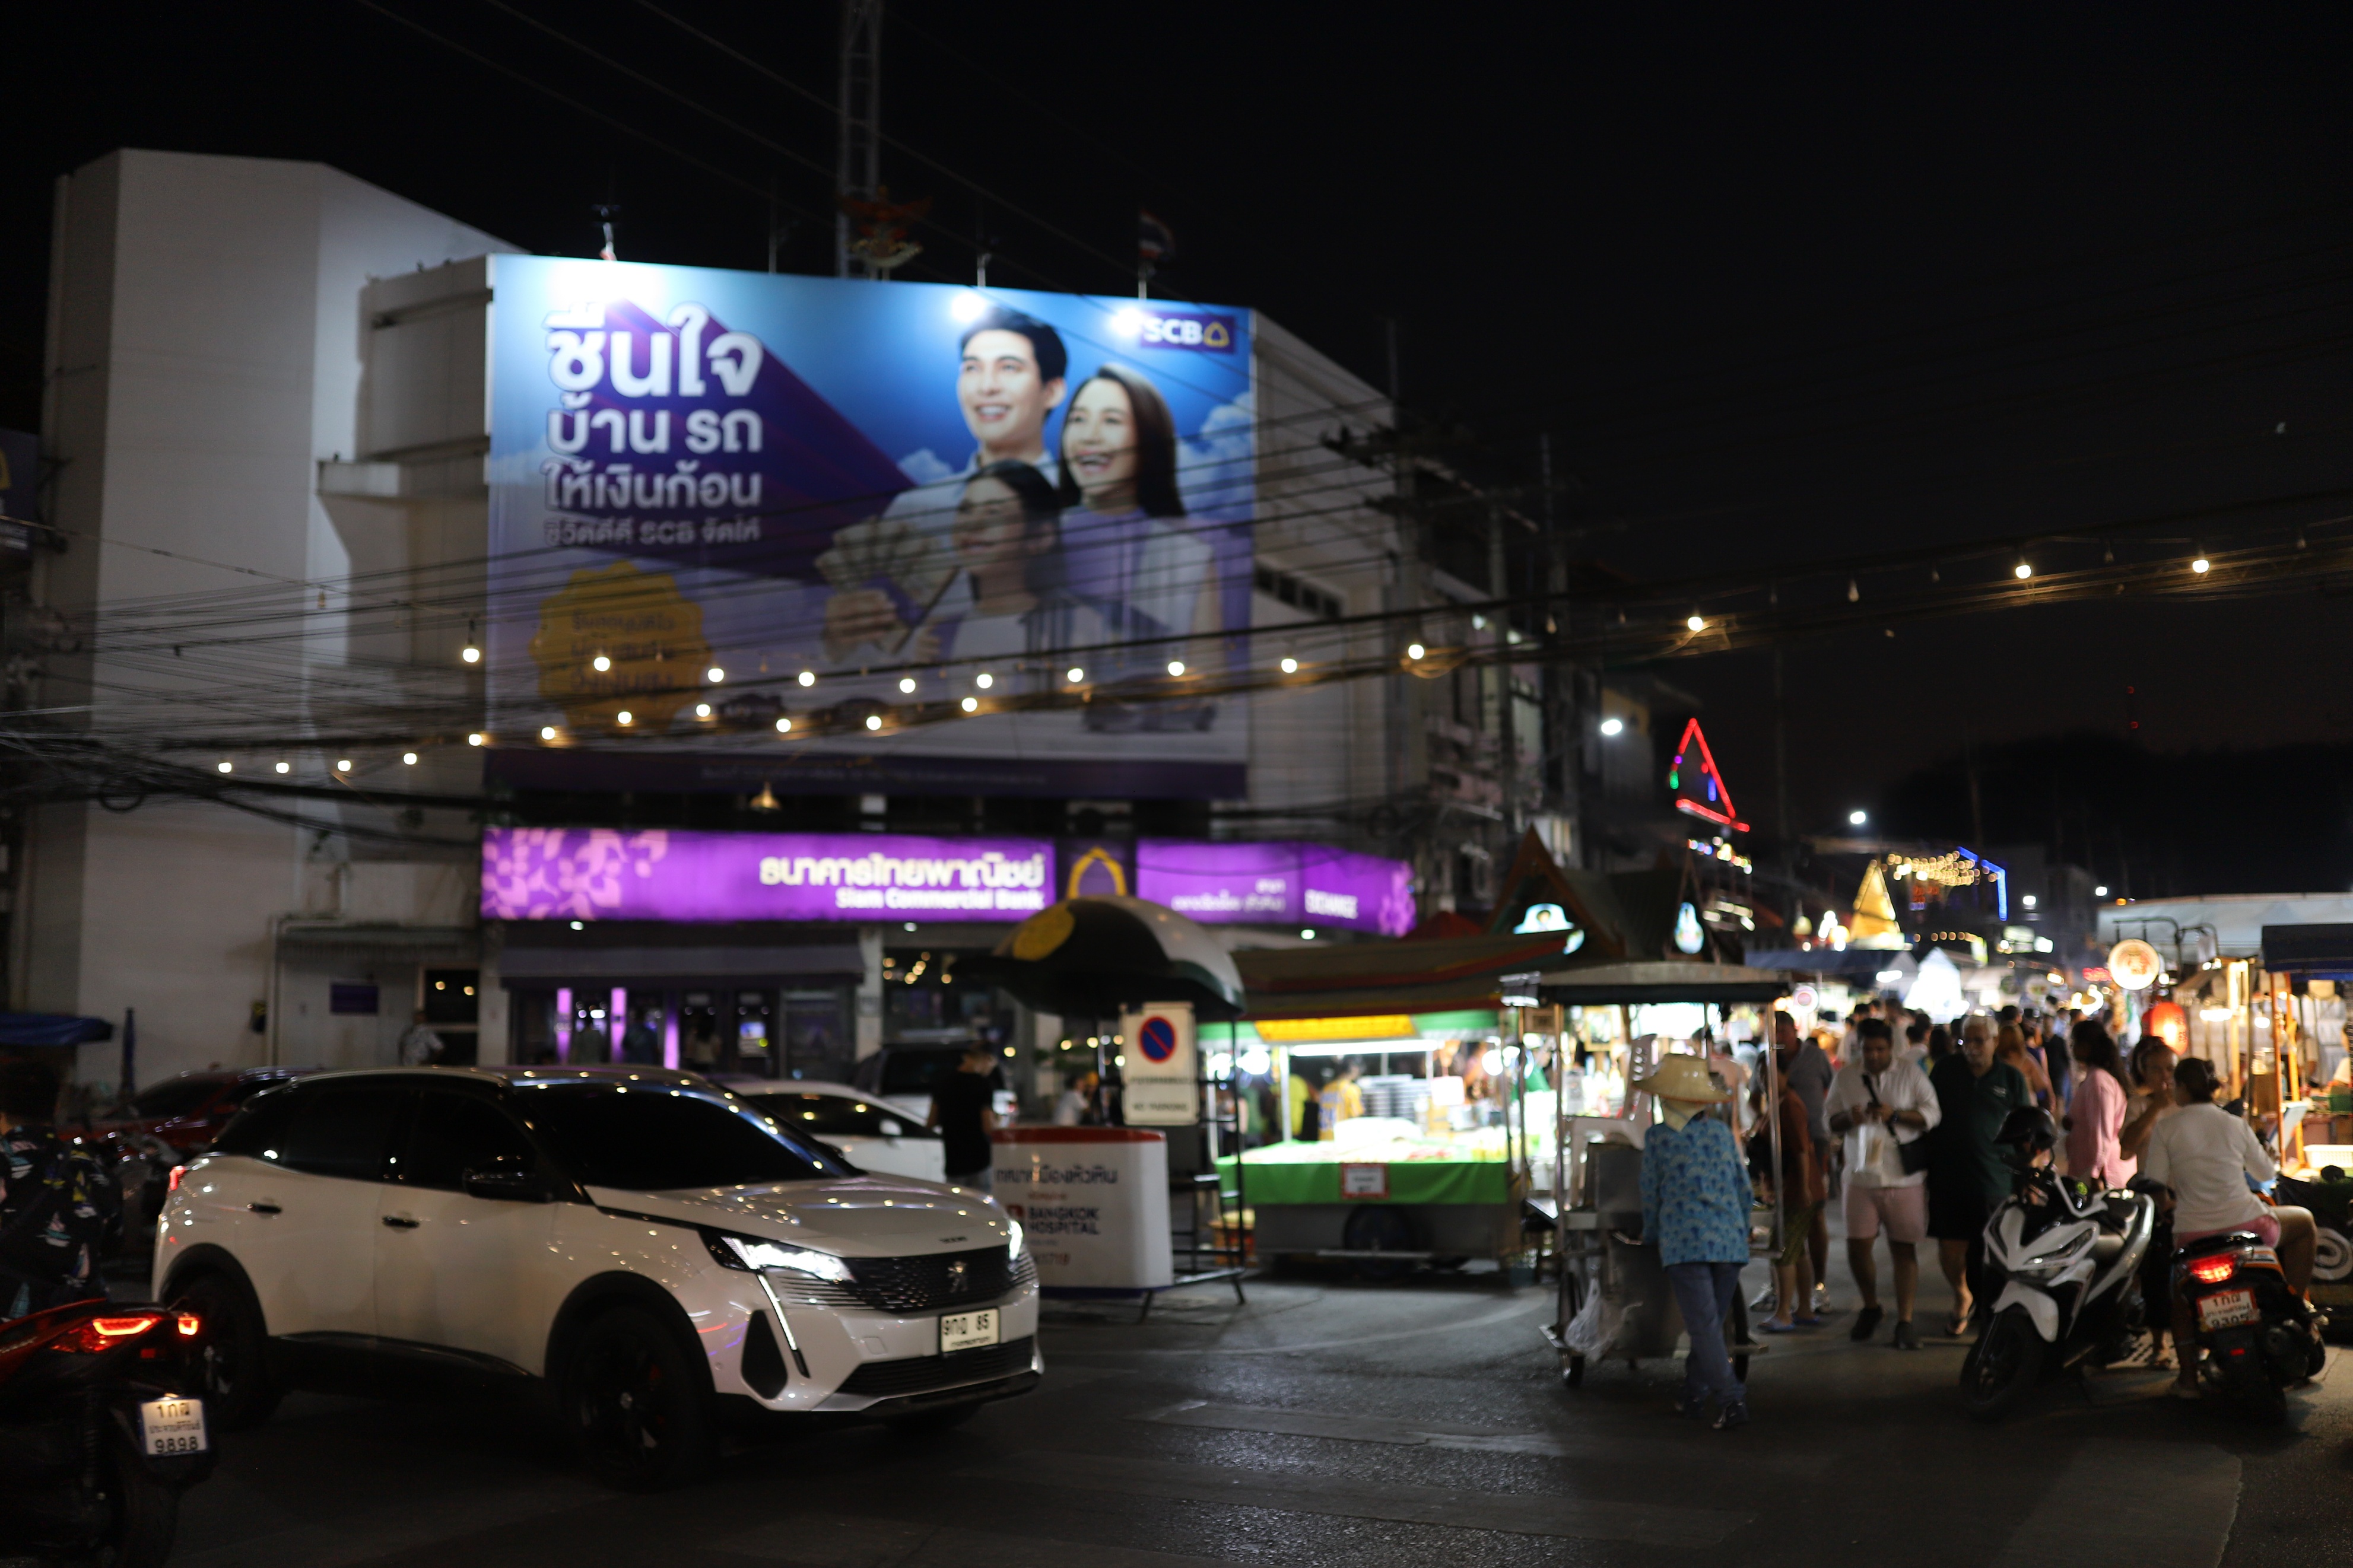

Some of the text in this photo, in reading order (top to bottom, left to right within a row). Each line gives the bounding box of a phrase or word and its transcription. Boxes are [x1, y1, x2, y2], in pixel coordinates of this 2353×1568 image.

[1142, 316, 1204, 345] SCB
[542, 301, 763, 397] ชืนใจ
[547, 391, 763, 454] บ้าน รถ
[541, 459, 763, 508] ให้เงินก้อน
[639, 520, 694, 545] SCB
[760, 852, 1046, 888] ธนาคารไทยพาณิชย์
[1027, 1221, 1100, 1235] HOSPITAL
[1028, 1207, 1100, 1221] BANGKOK
[155, 1436, 198, 1453] 9898
